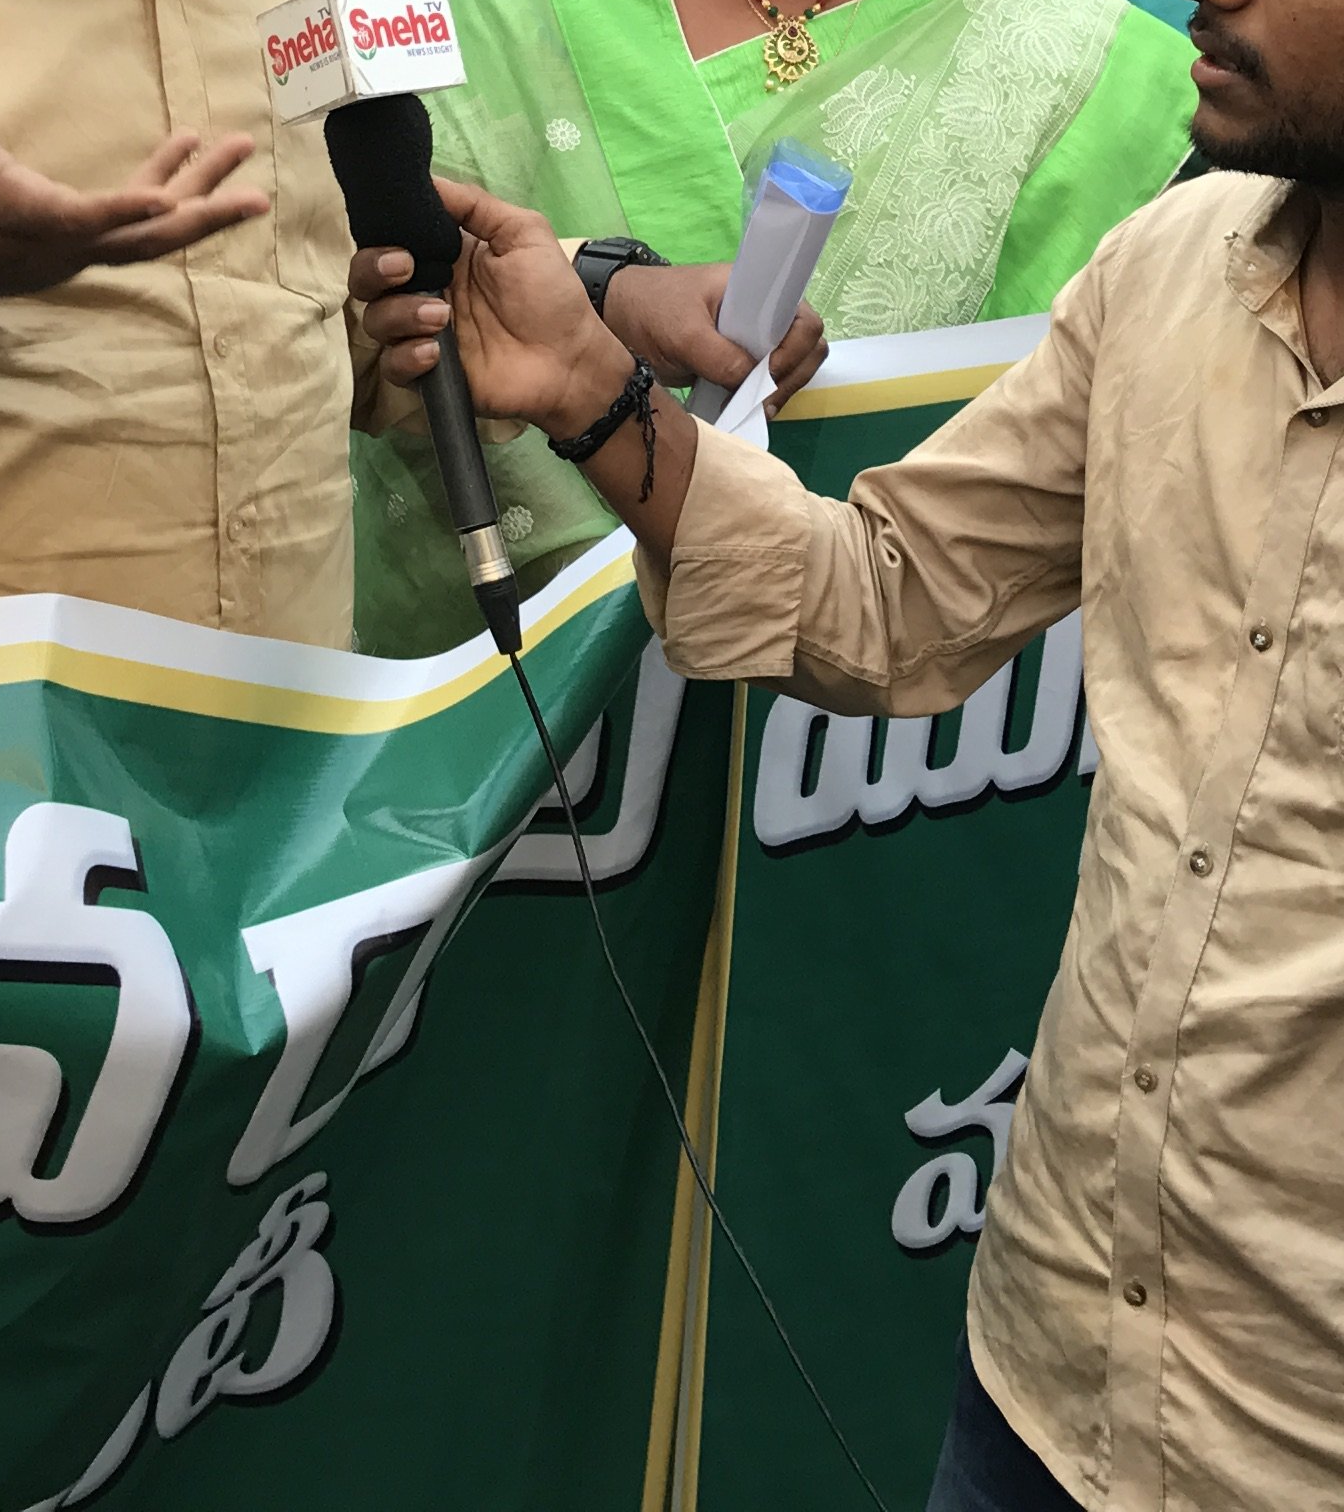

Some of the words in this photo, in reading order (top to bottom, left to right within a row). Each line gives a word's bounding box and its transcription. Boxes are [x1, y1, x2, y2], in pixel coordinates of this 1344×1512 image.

[423, 1, 442, 12] TV
[349, 4, 451, 50] Sneha
[268, 16, 340, 76] Sneha
[406, 47, 427, 57] NEWS
[434, 44, 453, 55] RIGHT
